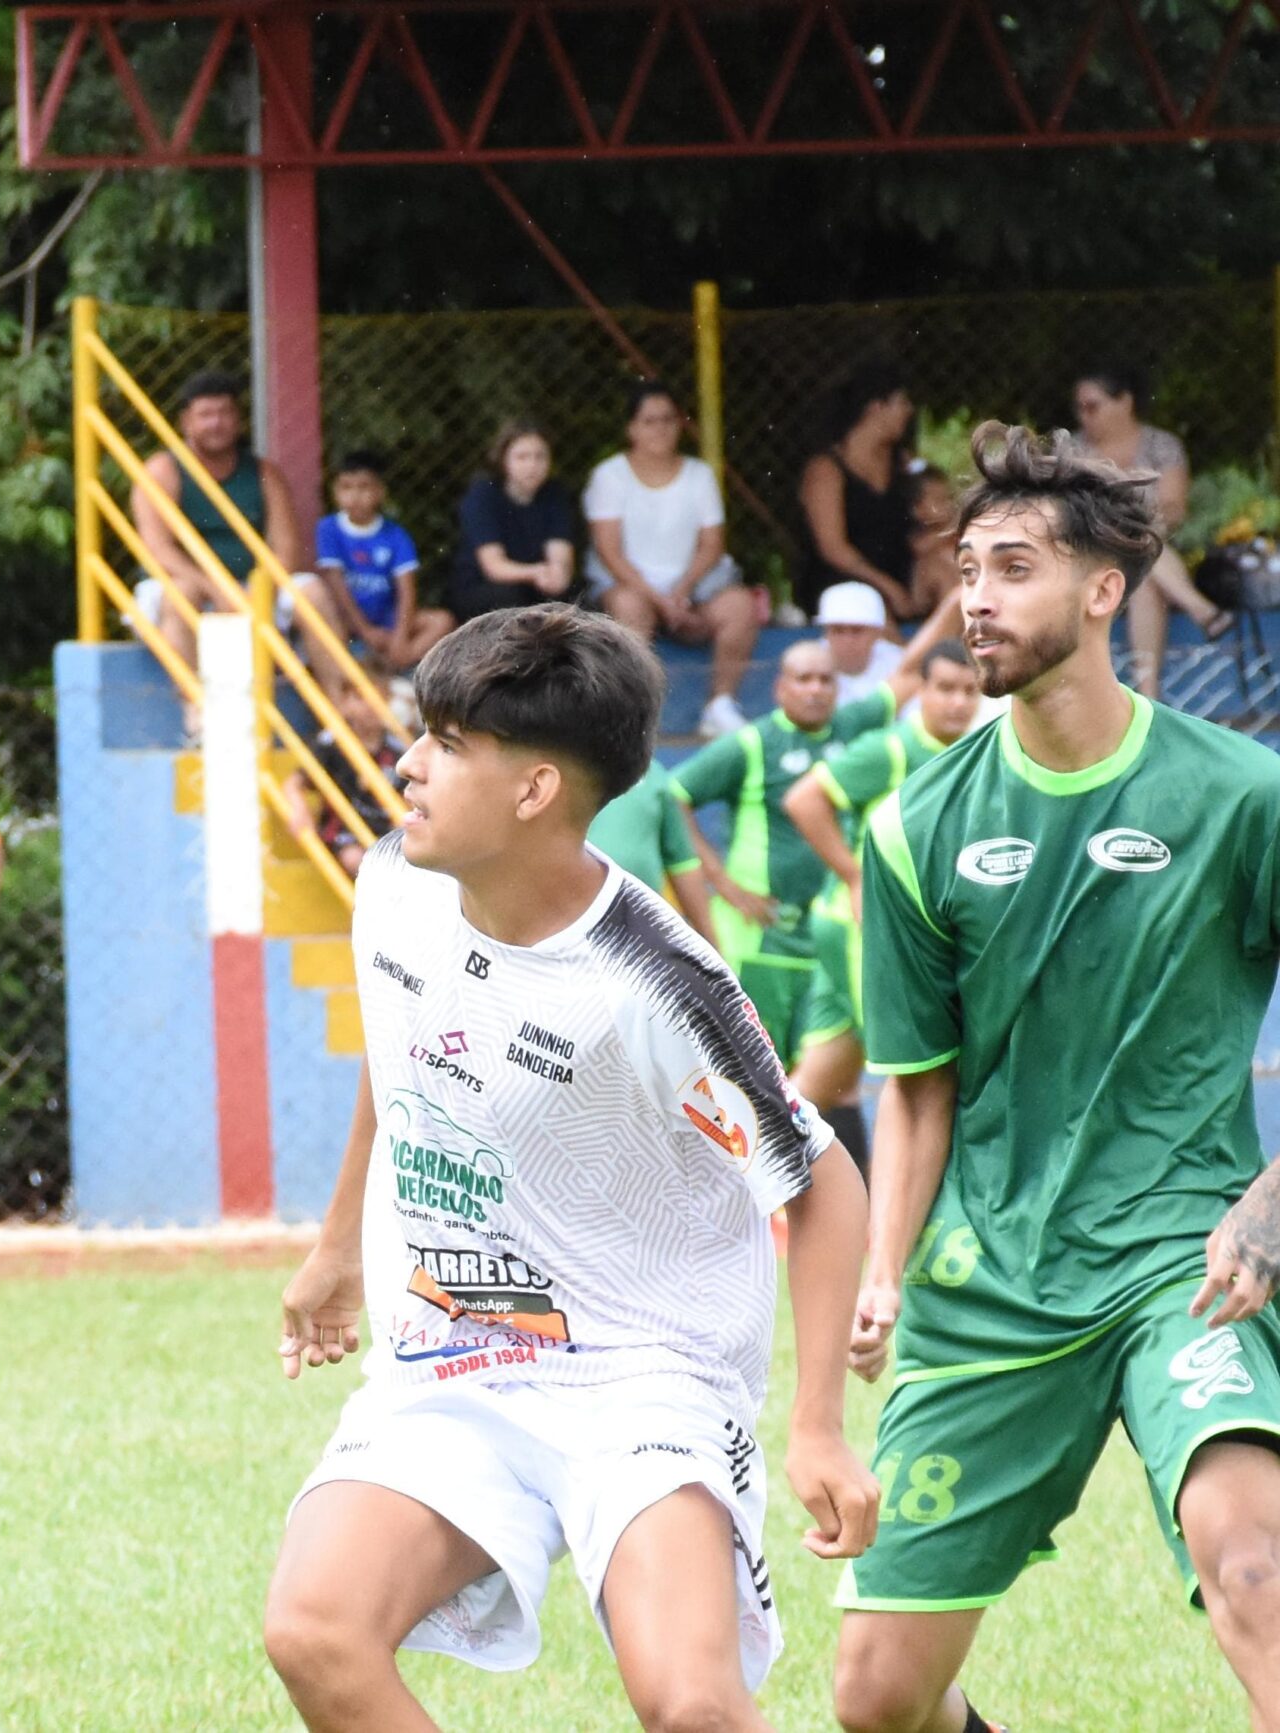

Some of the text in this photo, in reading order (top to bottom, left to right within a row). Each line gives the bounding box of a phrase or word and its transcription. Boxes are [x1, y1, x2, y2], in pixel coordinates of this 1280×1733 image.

[517, 1020, 575, 1060] JUNINHO
[506, 1042, 574, 1084] BANDEIRA
[389, 1135, 504, 1204] ICARDINHO
[433, 1345, 538, 1381] DESDE 1994
[878, 1452, 963, 1524] 18
